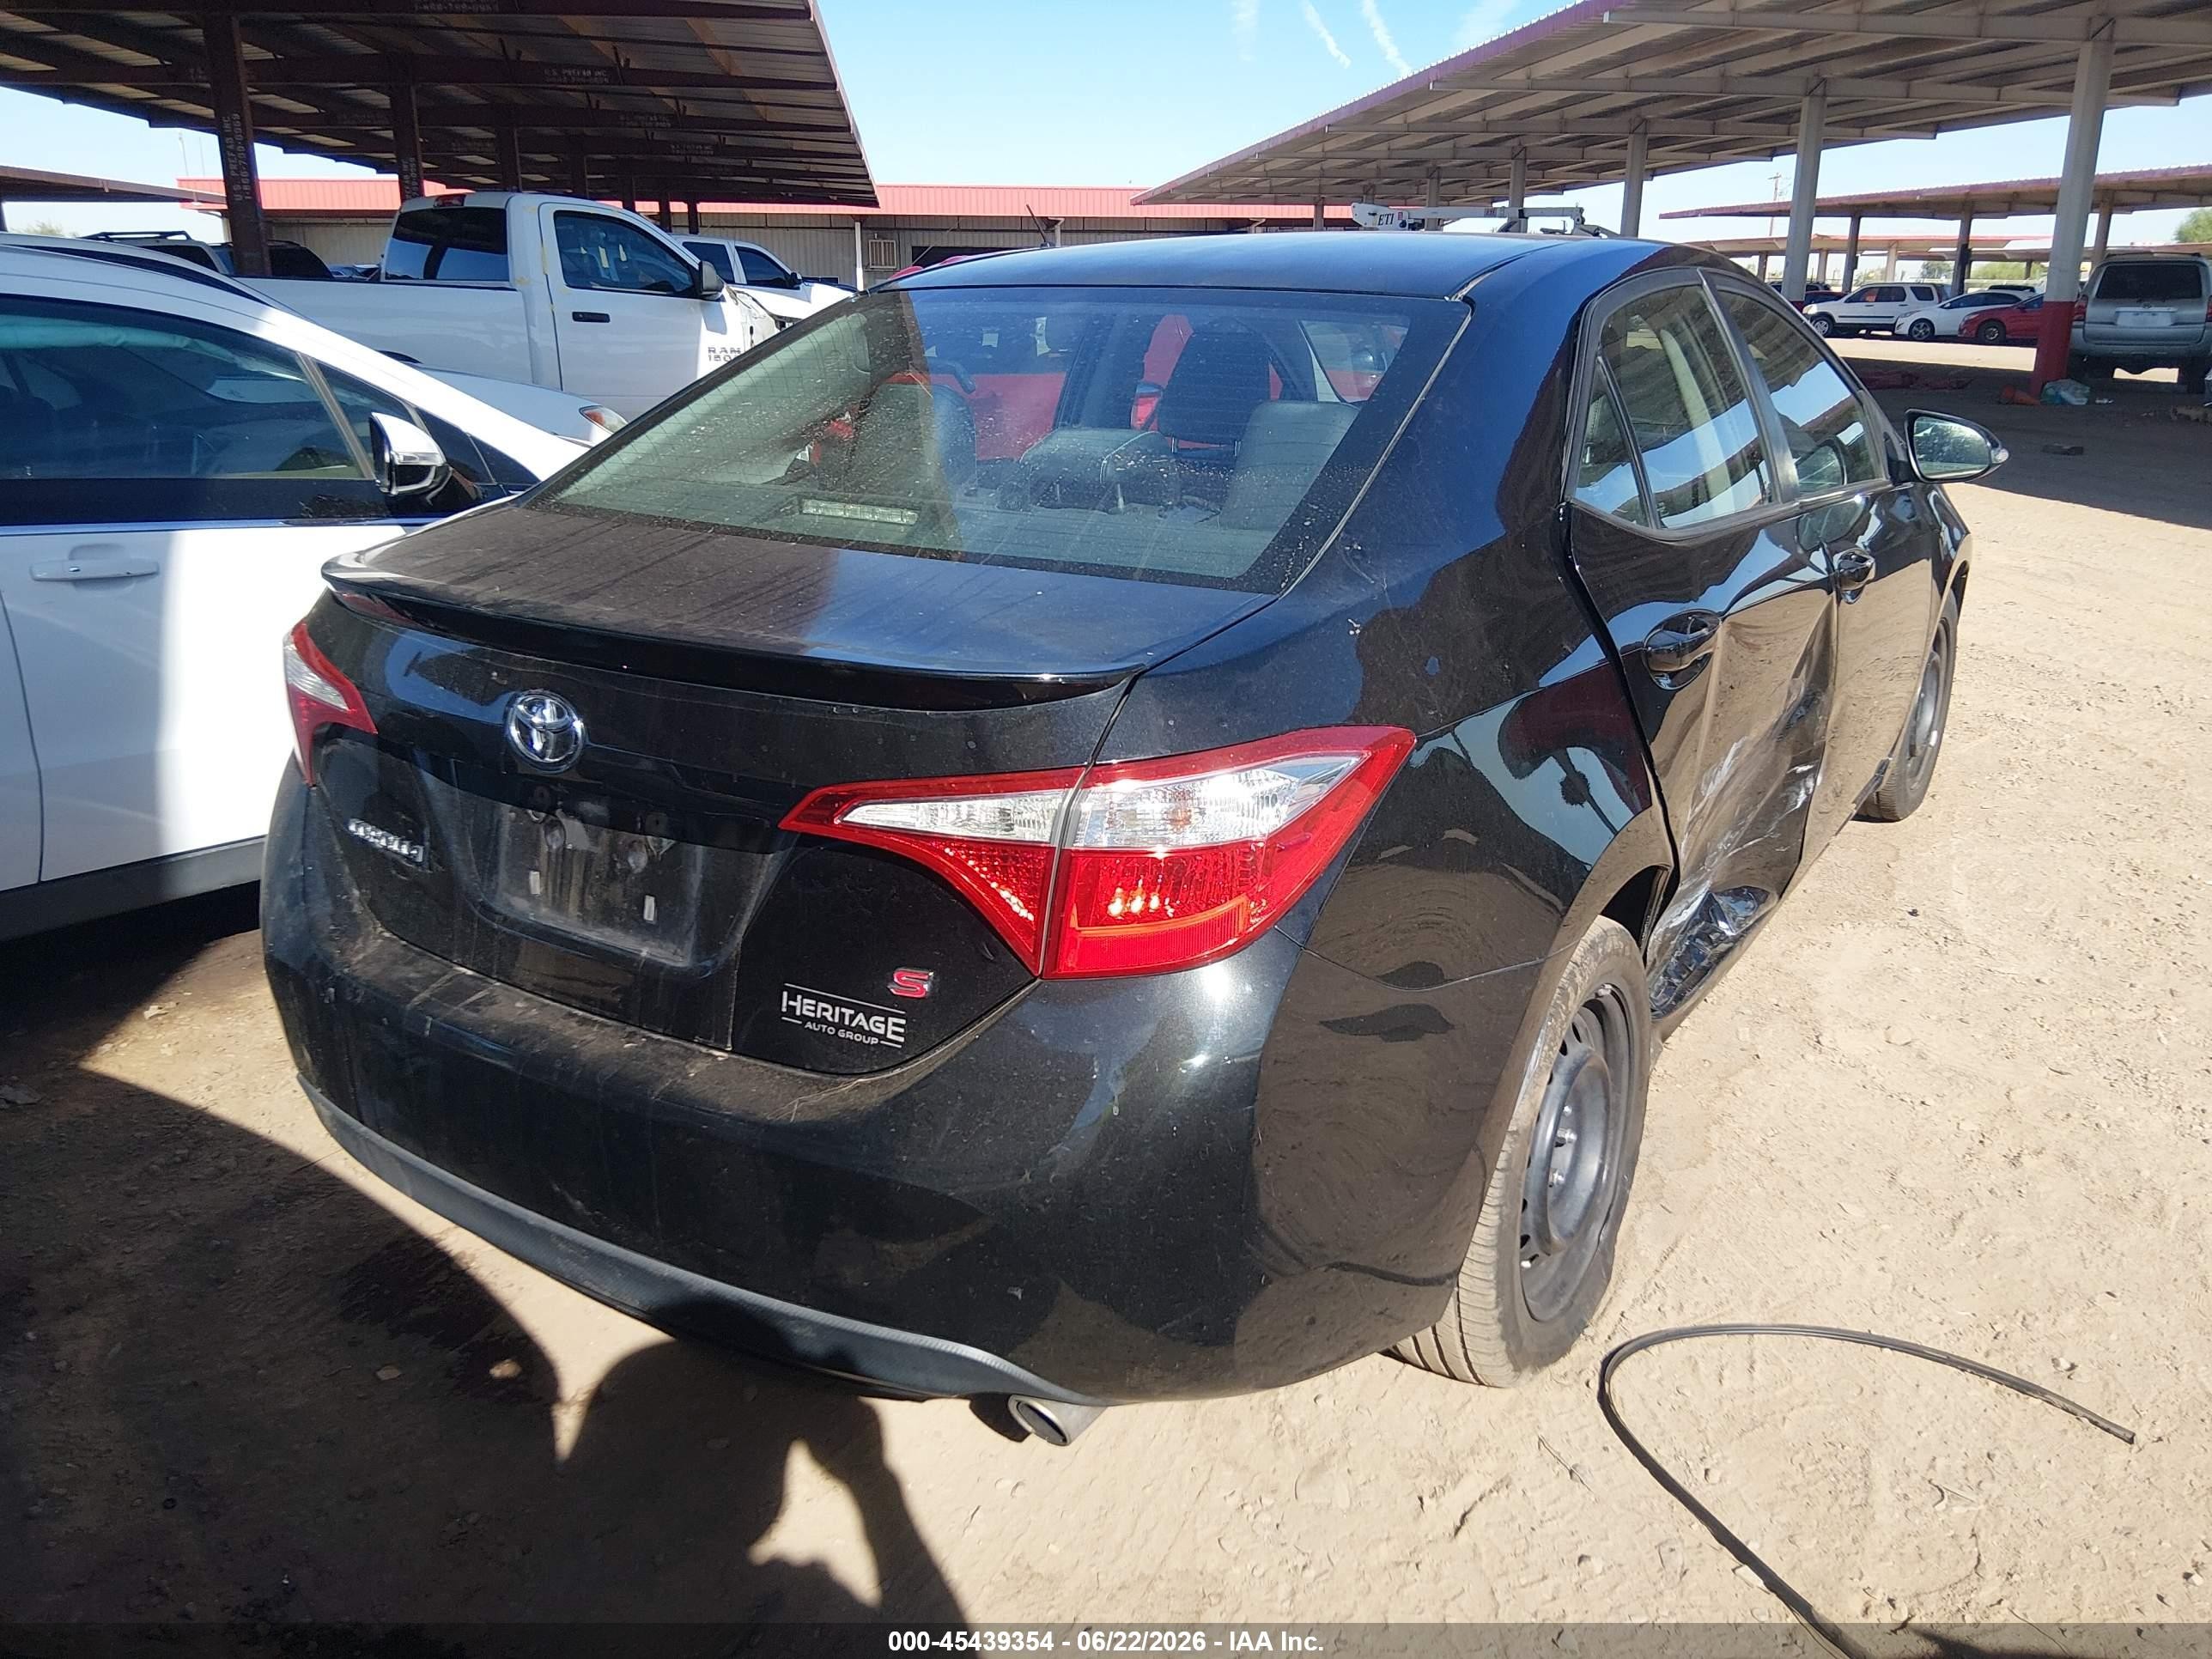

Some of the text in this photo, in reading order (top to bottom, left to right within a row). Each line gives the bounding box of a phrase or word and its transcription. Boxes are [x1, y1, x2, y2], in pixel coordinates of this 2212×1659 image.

[222, 115, 233, 132] INC
[225, 137, 240, 177] PREFAB
[1377, 213, 1395, 226] ETI
[887, 967, 934, 999] S
[781, 990, 907, 1042] HERITAGE
[804, 1021, 879, 1045] AUTO GROUP
